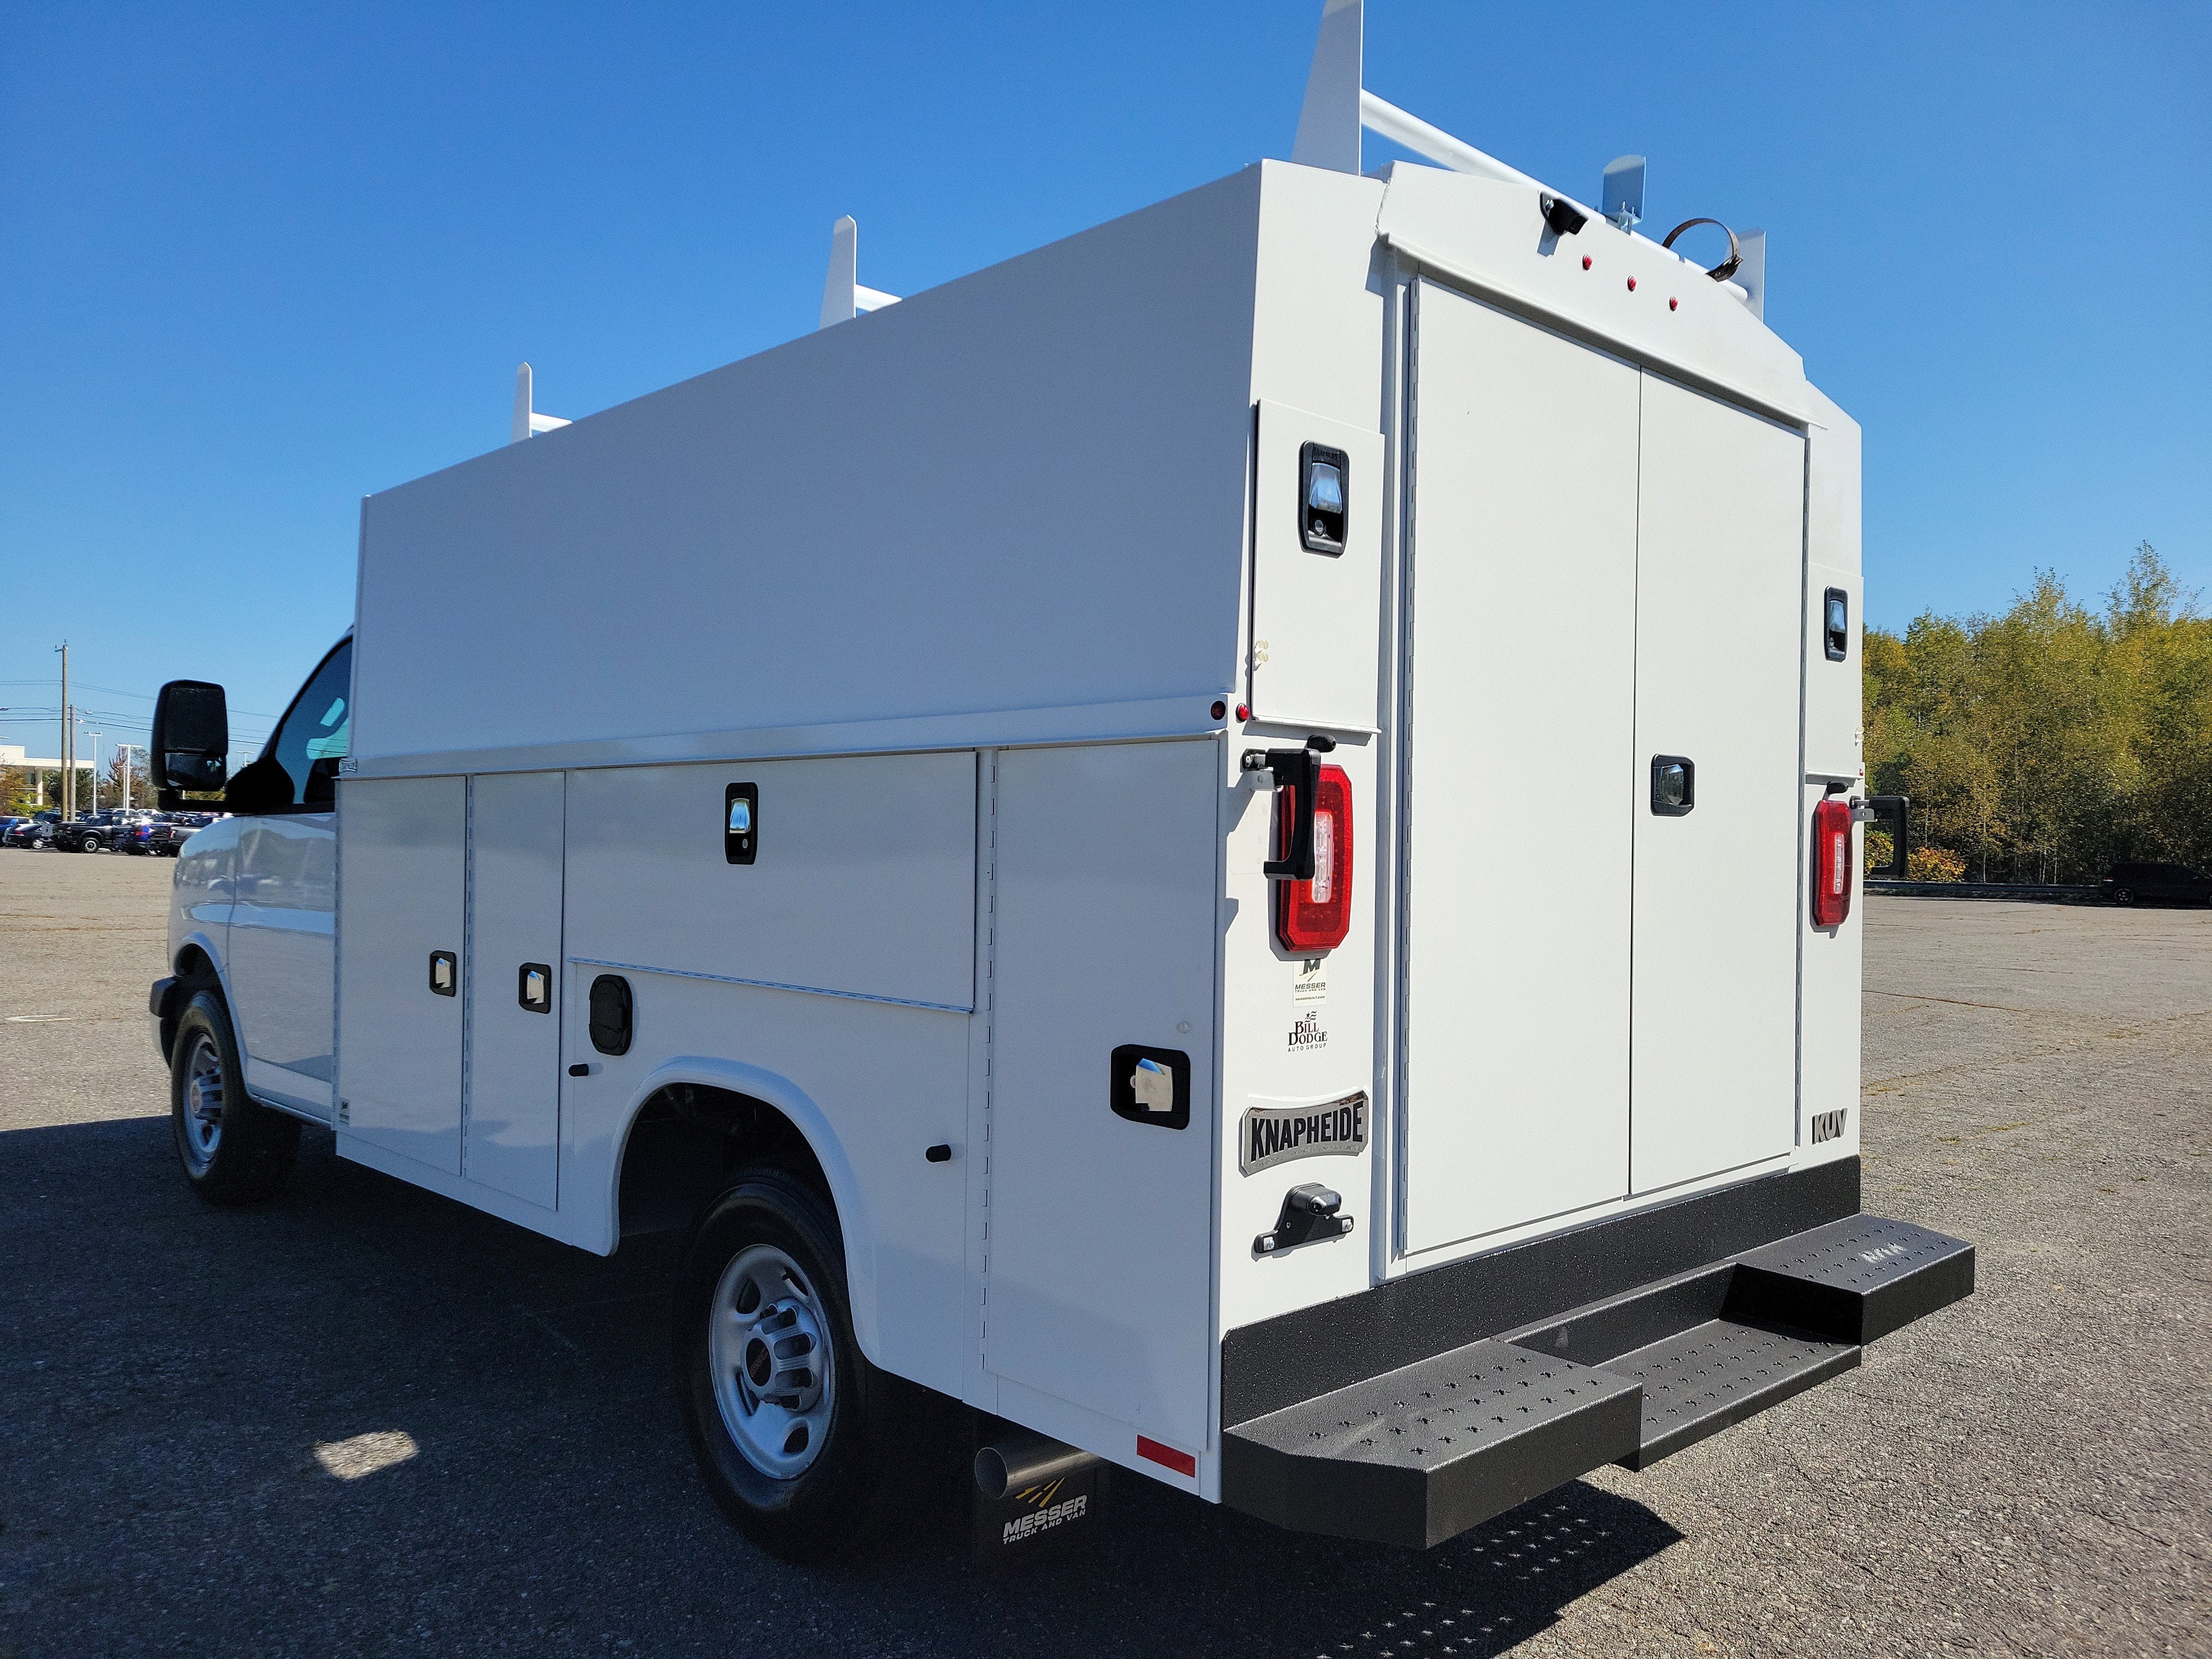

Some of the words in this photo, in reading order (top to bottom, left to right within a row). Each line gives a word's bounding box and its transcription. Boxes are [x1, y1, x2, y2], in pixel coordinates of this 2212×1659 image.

[1288, 1031, 1328, 1046] DODGE
[1295, 1021, 1319, 1034] BILL
[1306, 1042, 1327, 1051] GROUP
[1251, 1100, 1364, 1163] KNAPHEIDE
[1812, 1107, 1848, 1145] KUV
[1003, 1494, 1087, 1538] MESSER
[1003, 1526, 1038, 1544] TRUCK
[1041, 1517, 1062, 1531] AND
[1066, 1508, 1086, 1521] VAN
